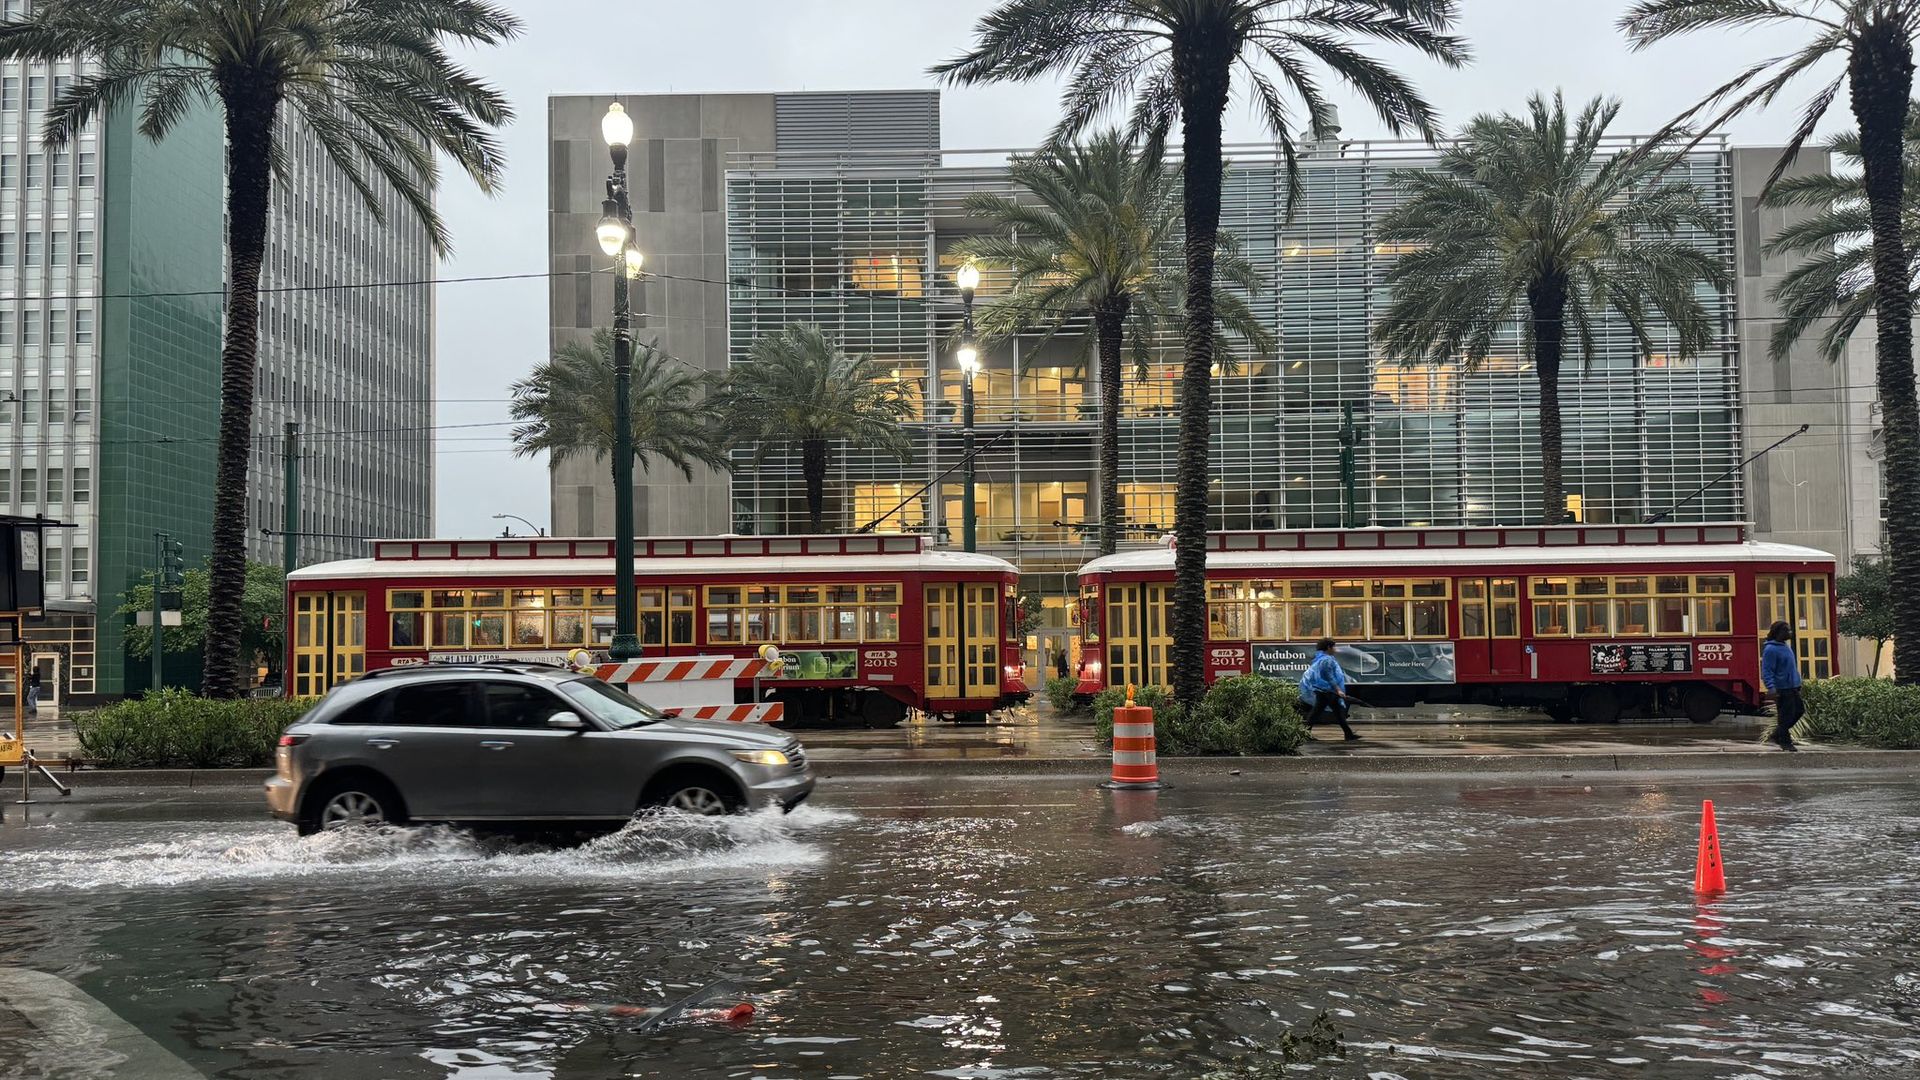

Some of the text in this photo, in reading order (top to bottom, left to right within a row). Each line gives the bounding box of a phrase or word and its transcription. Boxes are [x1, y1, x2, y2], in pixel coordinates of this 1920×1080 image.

[1258, 650, 1306, 660] Audubon
[1597, 651, 1621, 663] Fest
[1697, 652, 1733, 661] 2017
[864, 659, 898, 667] 2018
[1211, 657, 1246, 666] 2017
[1258, 661, 1310, 673] Aquarium
